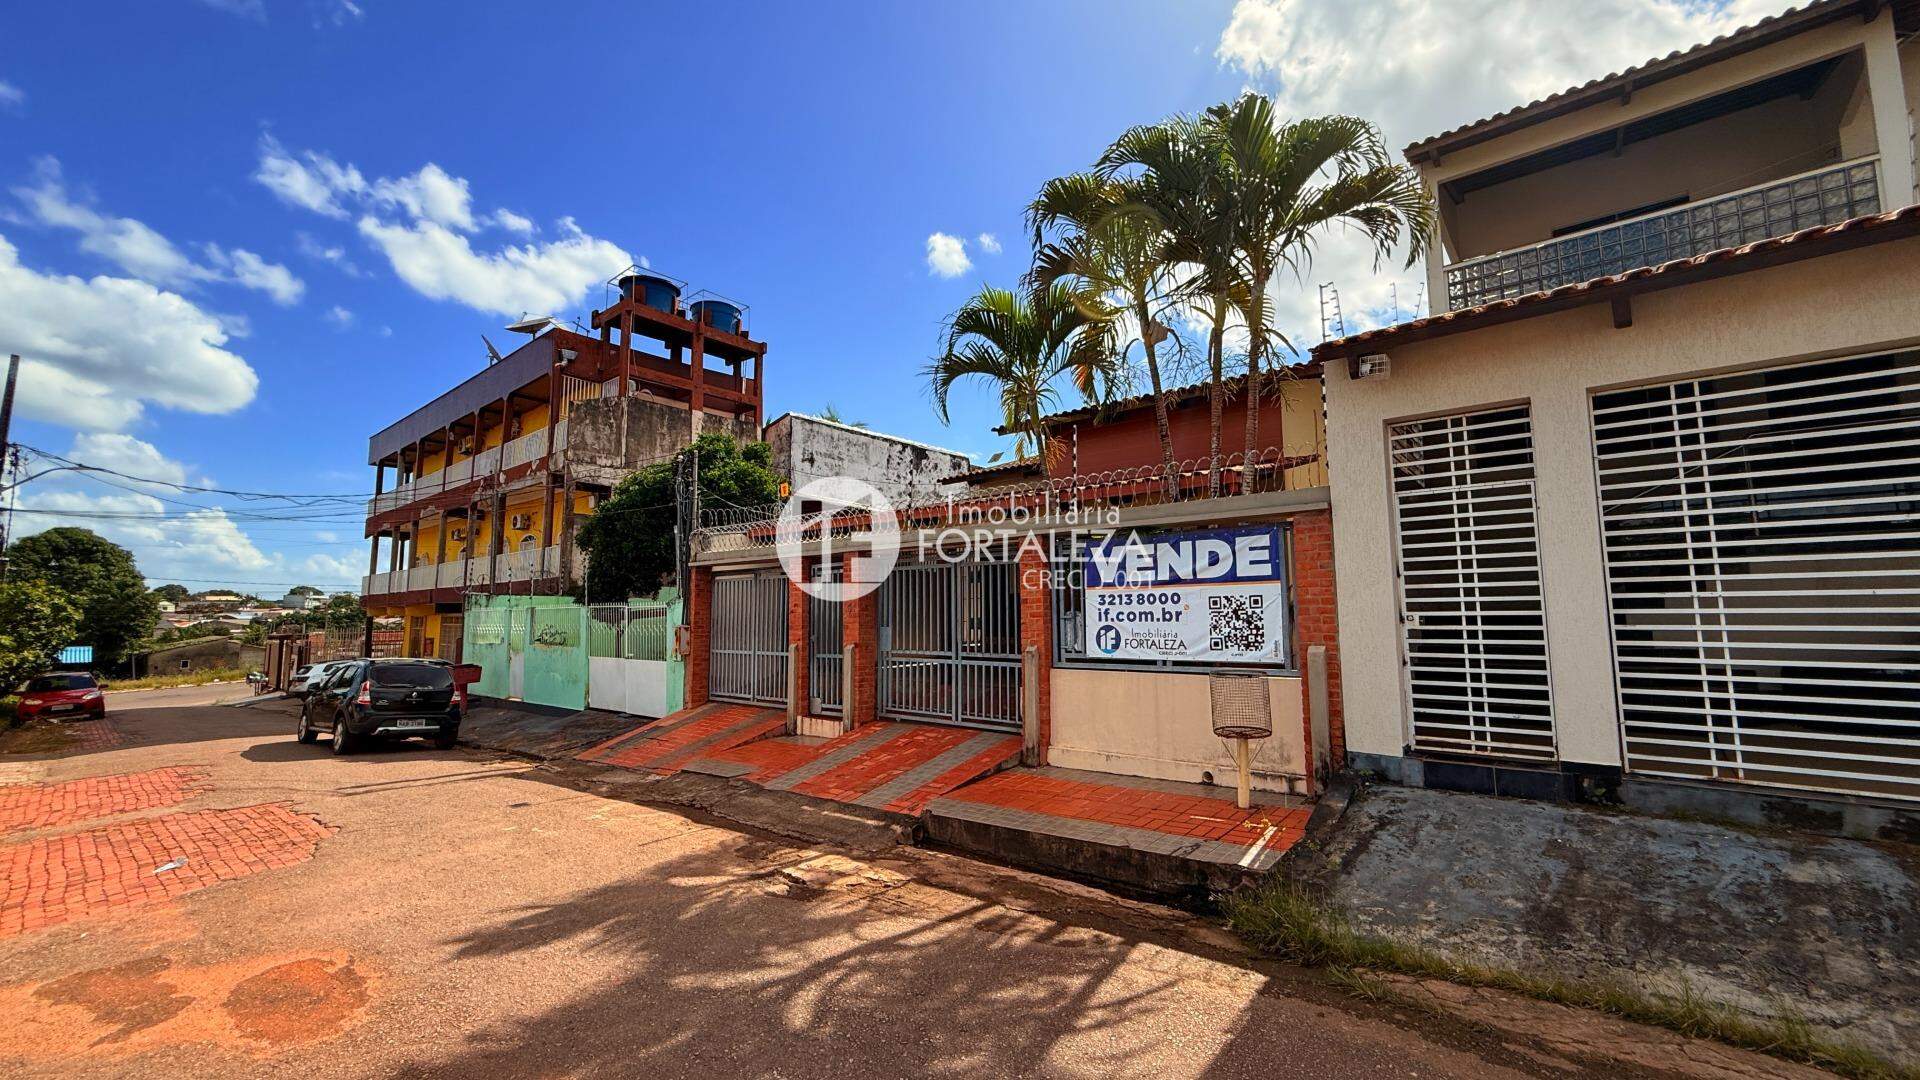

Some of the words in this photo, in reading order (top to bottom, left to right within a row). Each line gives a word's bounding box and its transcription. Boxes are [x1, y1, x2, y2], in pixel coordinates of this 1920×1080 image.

[1090, 534, 1272, 584] VENDE
[1097, 607, 1183, 623] if.com.br
[1124, 638, 1188, 651] FORTALEZA
